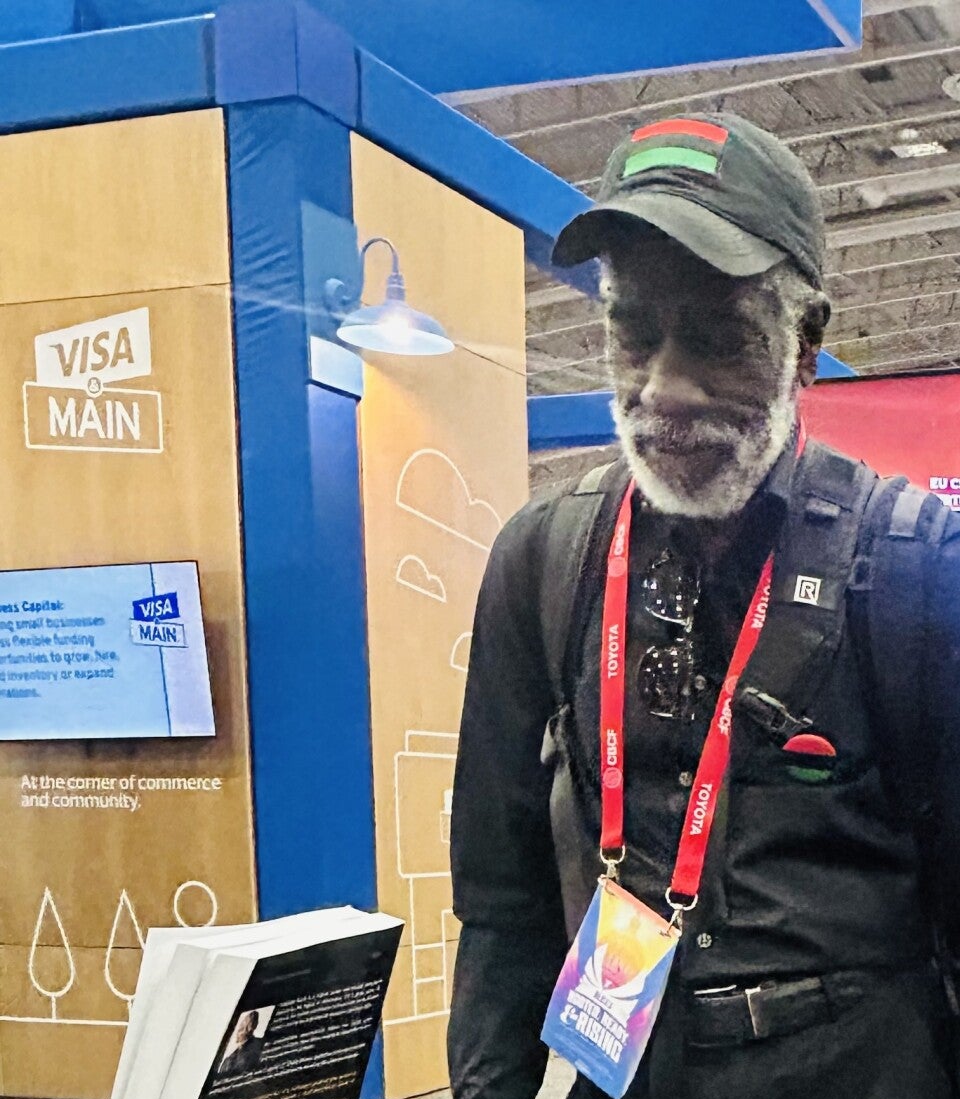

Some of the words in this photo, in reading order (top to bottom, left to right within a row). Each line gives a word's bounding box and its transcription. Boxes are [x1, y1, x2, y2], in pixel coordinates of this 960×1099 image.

[49, 327, 135, 377] VISA
[48, 396, 140, 440] MAIN
[929, 477, 948, 490] EU
[139, 599, 173, 617] VISA
[139, 625, 177, 642] MAIN
[49, 651, 62, 663] to
[607, 624, 619, 679] TOYOTA
[606, 729, 618, 766] CBCF
[21, 775, 37, 790] At
[39, 775, 65, 790] the
[66, 777, 115, 790] corner
[119, 776, 135, 790] of
[138, 777, 222, 790] commerce
[21, 792, 49, 808] and
[51, 792, 142, 812] community.
[689, 782, 713, 836] TOYOTA
[575, 1011, 623, 1064] RISING
